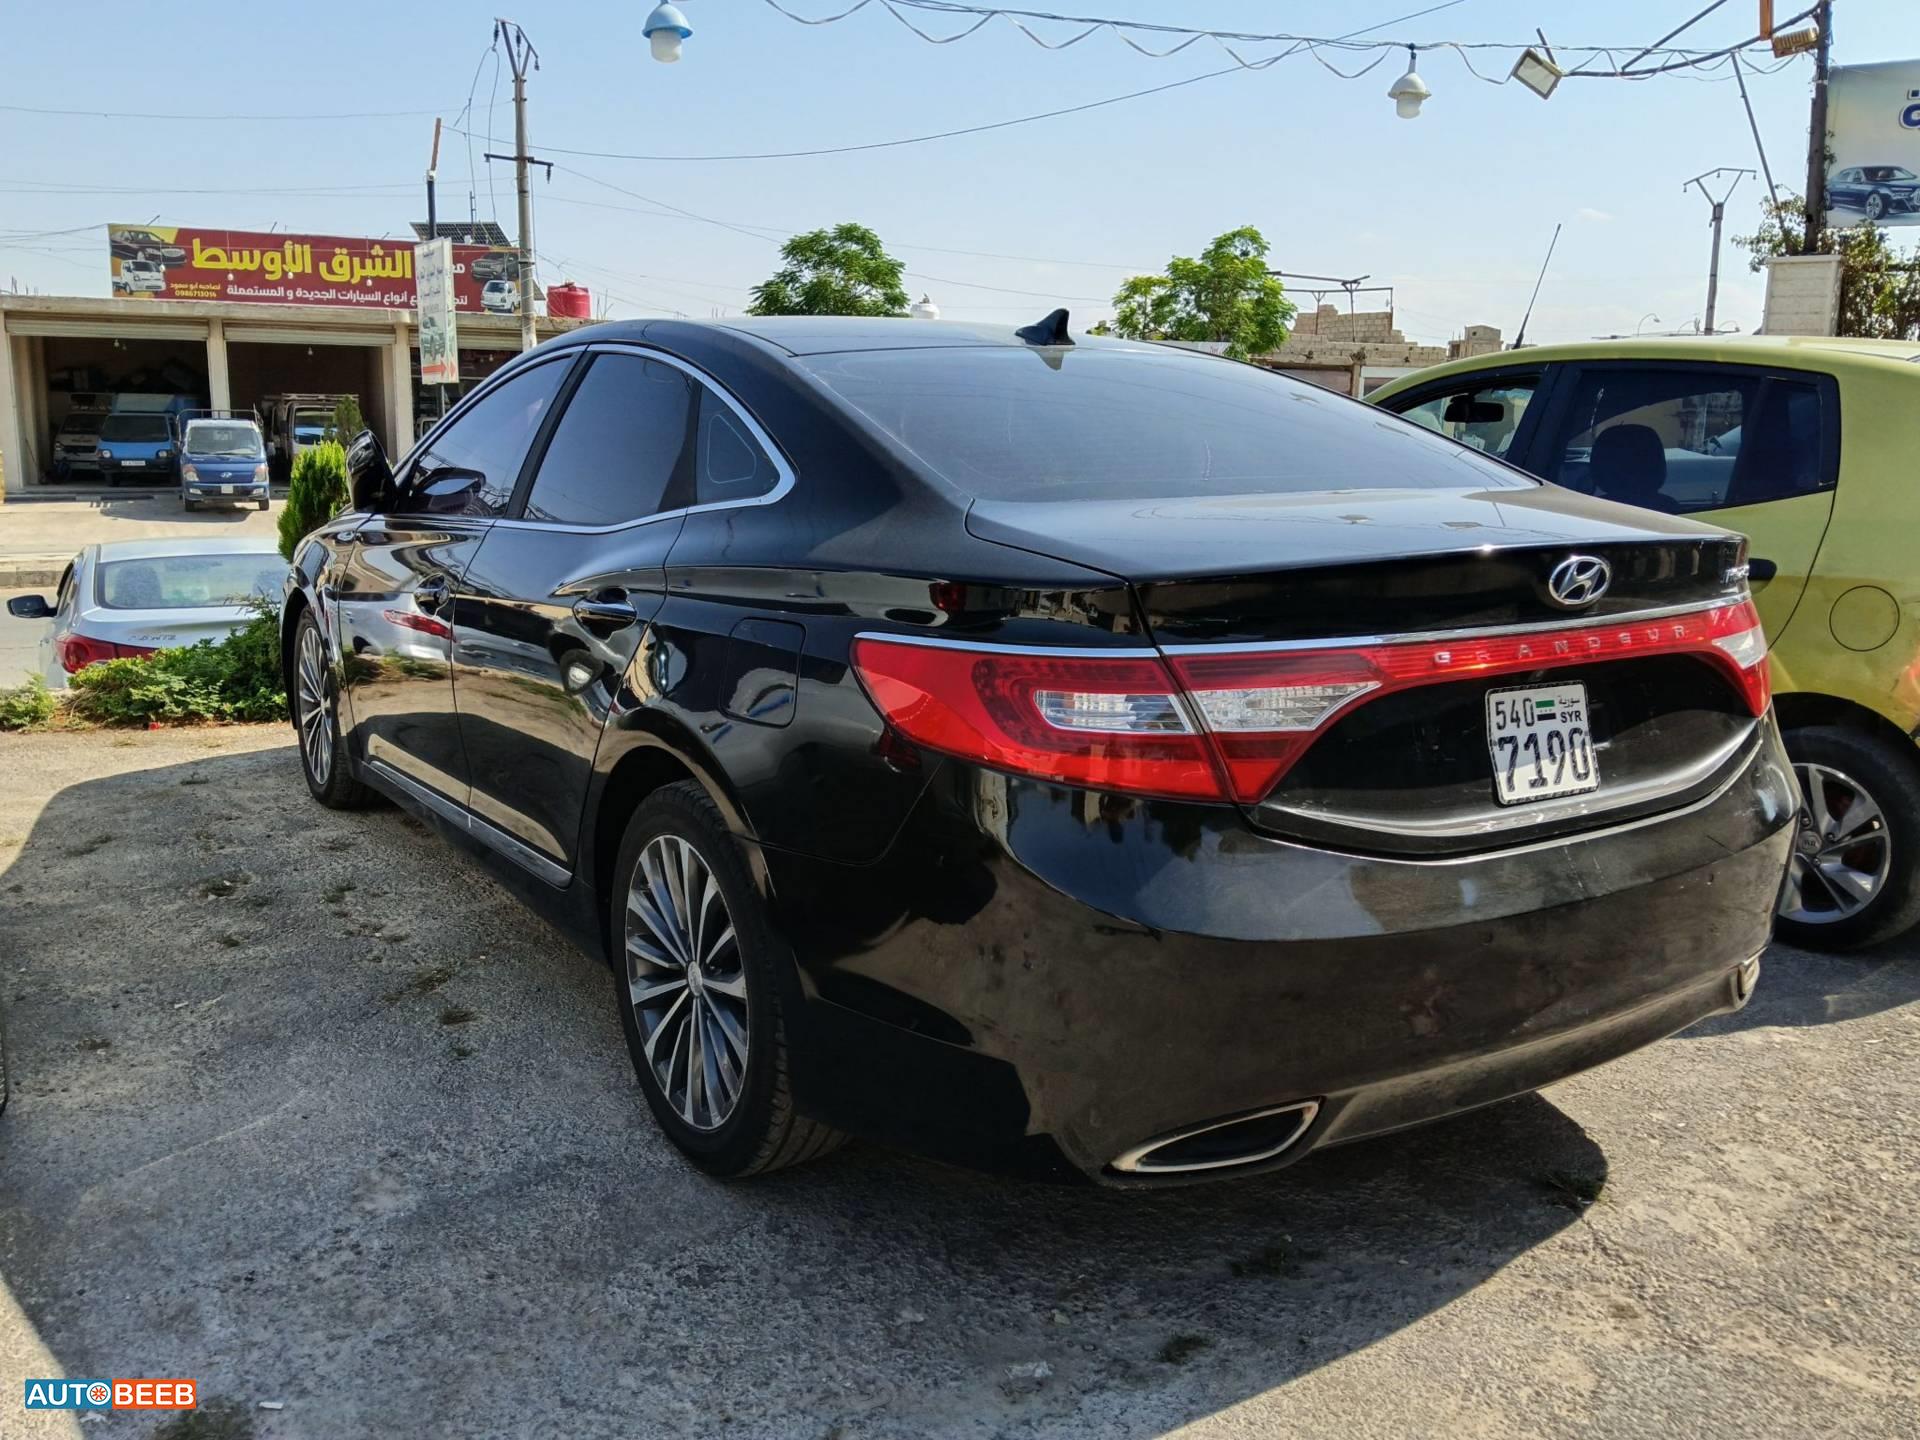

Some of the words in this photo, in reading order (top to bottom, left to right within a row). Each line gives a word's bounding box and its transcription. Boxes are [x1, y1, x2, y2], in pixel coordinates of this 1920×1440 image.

[192, 238, 313, 280] الأوسط
[319, 244, 412, 284] الشرق
[226, 284, 285, 298] المستعملة
[286, 288, 294, 300] و
[296, 287, 336, 301] الجديدة
[338, 288, 381, 303] السيارات
[1434, 625, 1687, 665] GRANDEUR
[1557, 695, 1581, 708] سورية
[1495, 698, 1535, 731] 540
[1560, 710, 1583, 724] SYR
[1497, 727, 1591, 793] 7190
